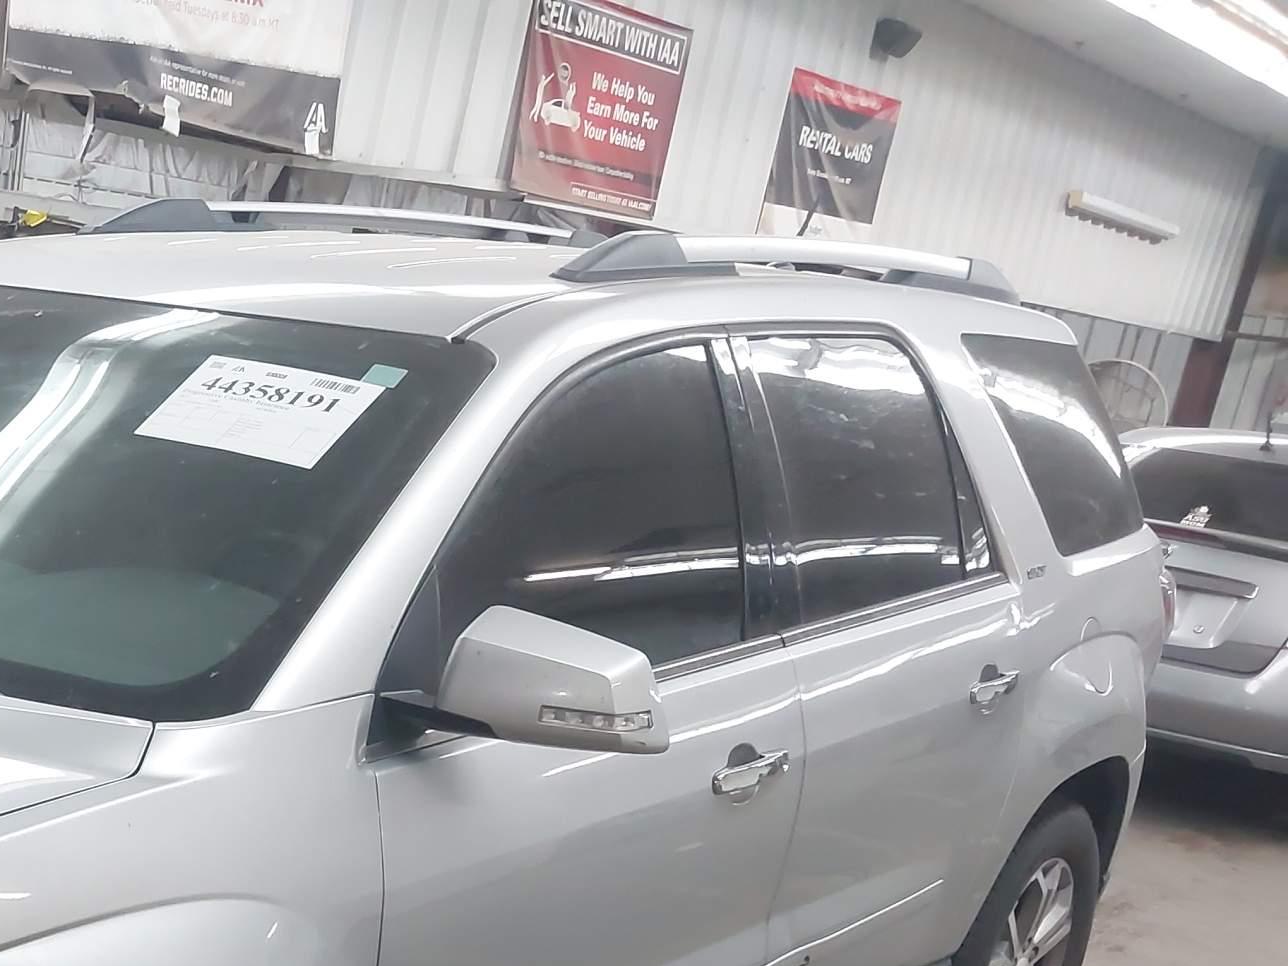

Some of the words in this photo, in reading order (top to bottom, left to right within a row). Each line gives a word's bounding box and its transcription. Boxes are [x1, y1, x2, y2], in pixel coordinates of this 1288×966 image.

[540, 0, 572, 36] SELL
[575, 11, 625, 46] SMART
[624, 27, 657, 57] WITH
[657, 37, 680, 67] IAA
[160, 72, 233, 107] RECRIDES.COM
[591, 72, 609, 92] We
[611, 79, 634, 101] Help
[636, 84, 656, 106] You
[586, 96, 612, 118] Earn
[613, 103, 640, 126] More
[641, 110, 660, 132] For
[582, 120, 607, 142] Your
[609, 126, 646, 152] Vehicle
[201, 376, 342, 413] 44358191
